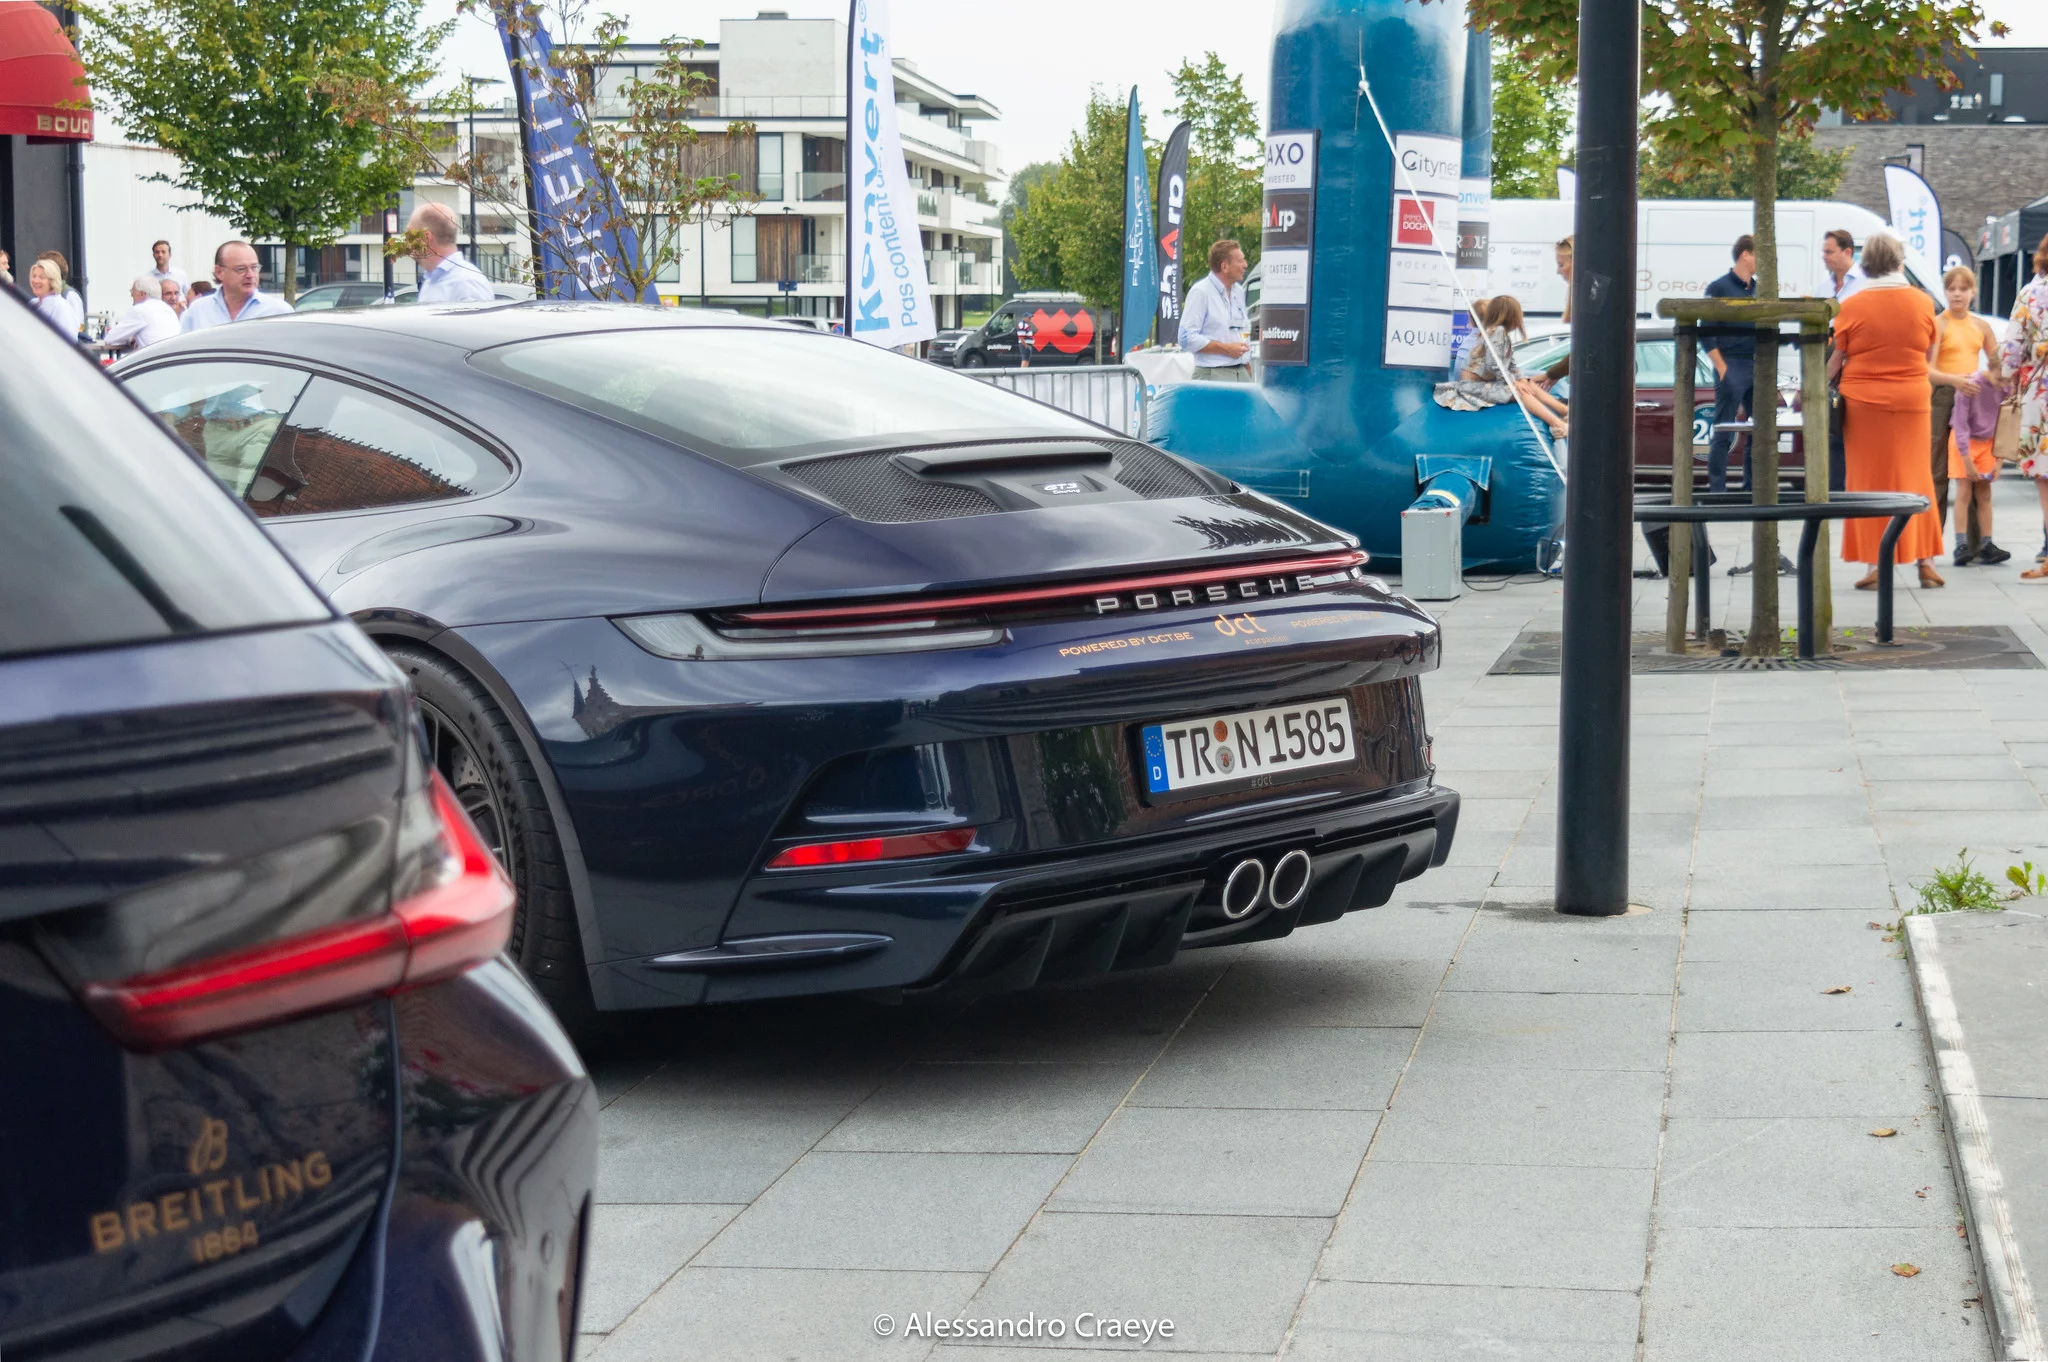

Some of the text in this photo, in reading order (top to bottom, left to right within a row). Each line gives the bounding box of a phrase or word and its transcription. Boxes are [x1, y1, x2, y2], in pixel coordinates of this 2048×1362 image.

[1266, 143, 1304, 166] AXO
[1402, 150, 1459, 177] Citynes
[855, 28, 890, 332] Konvert
[1263, 203, 1296, 232] hArp
[877, 193, 909, 279] content
[899, 284, 918, 327] Pas
[1391, 329, 1450, 346] AQUALE
[1692, 419, 1716, 445] 2
[1044, 483, 1077, 491] GT3
[1096, 574, 1314, 614] PORSCHE
[1214, 613, 1267, 637] dct
[1059, 631, 1194, 657] POWERED BY DCT.BE
[1153, 766, 1161, 781] D
[1165, 726, 1216, 779] TR
[1251, 774, 1273, 788] #dct
[90, 1151, 333, 1254] BREITLING
[191, 1220, 259, 1263] 1884
